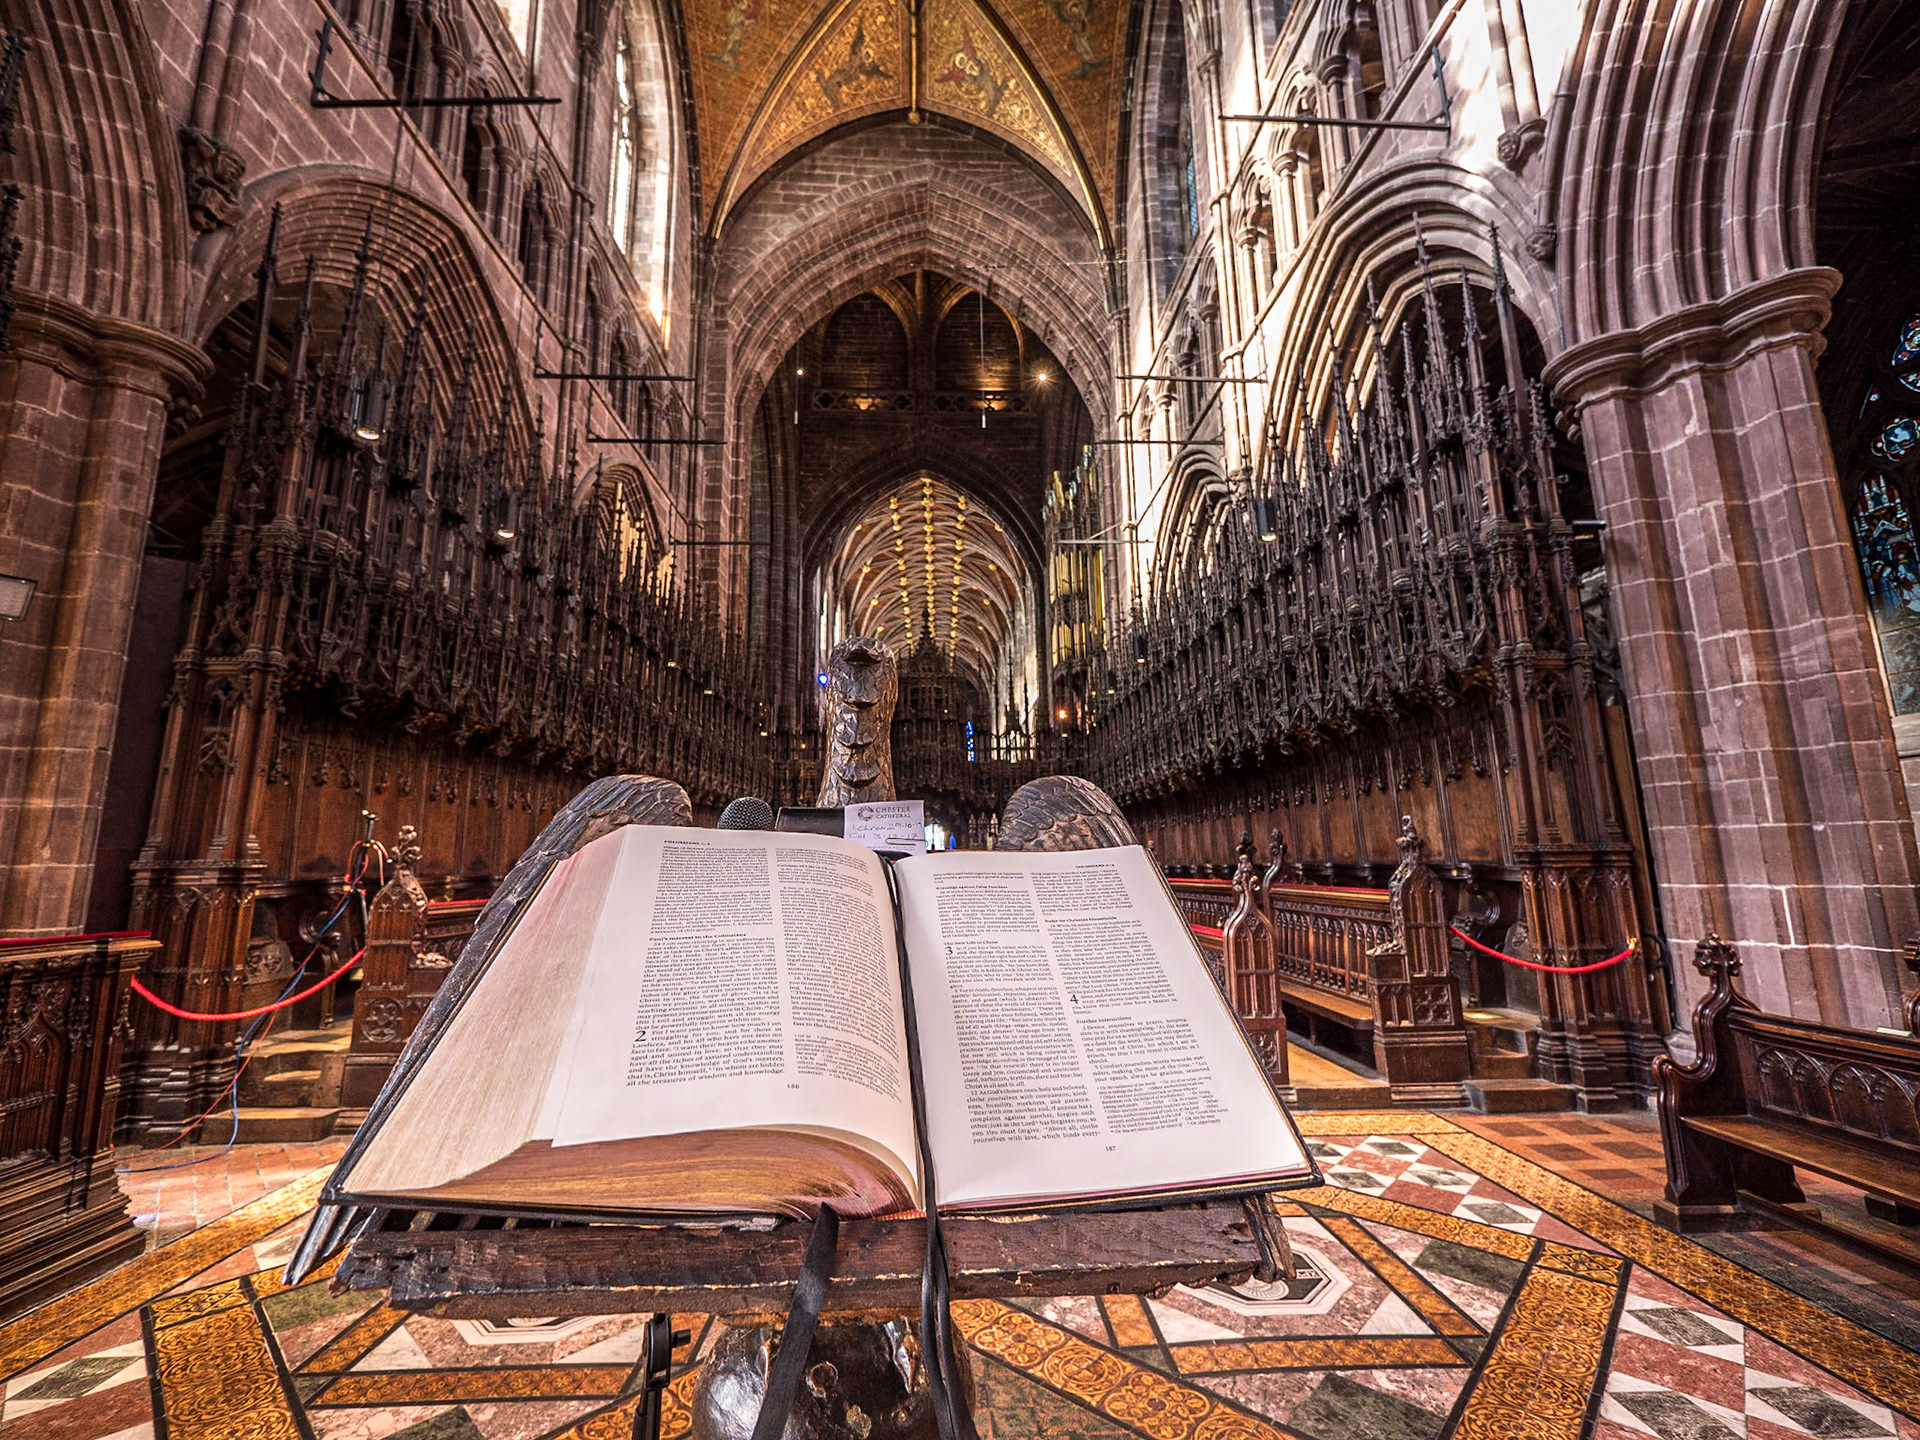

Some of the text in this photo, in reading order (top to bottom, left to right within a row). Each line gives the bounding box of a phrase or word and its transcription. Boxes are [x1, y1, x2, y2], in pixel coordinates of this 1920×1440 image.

[945, 946, 953, 955] 3
[1070, 995, 1079, 1004] 4
[634, 1030, 646, 1042] 2
